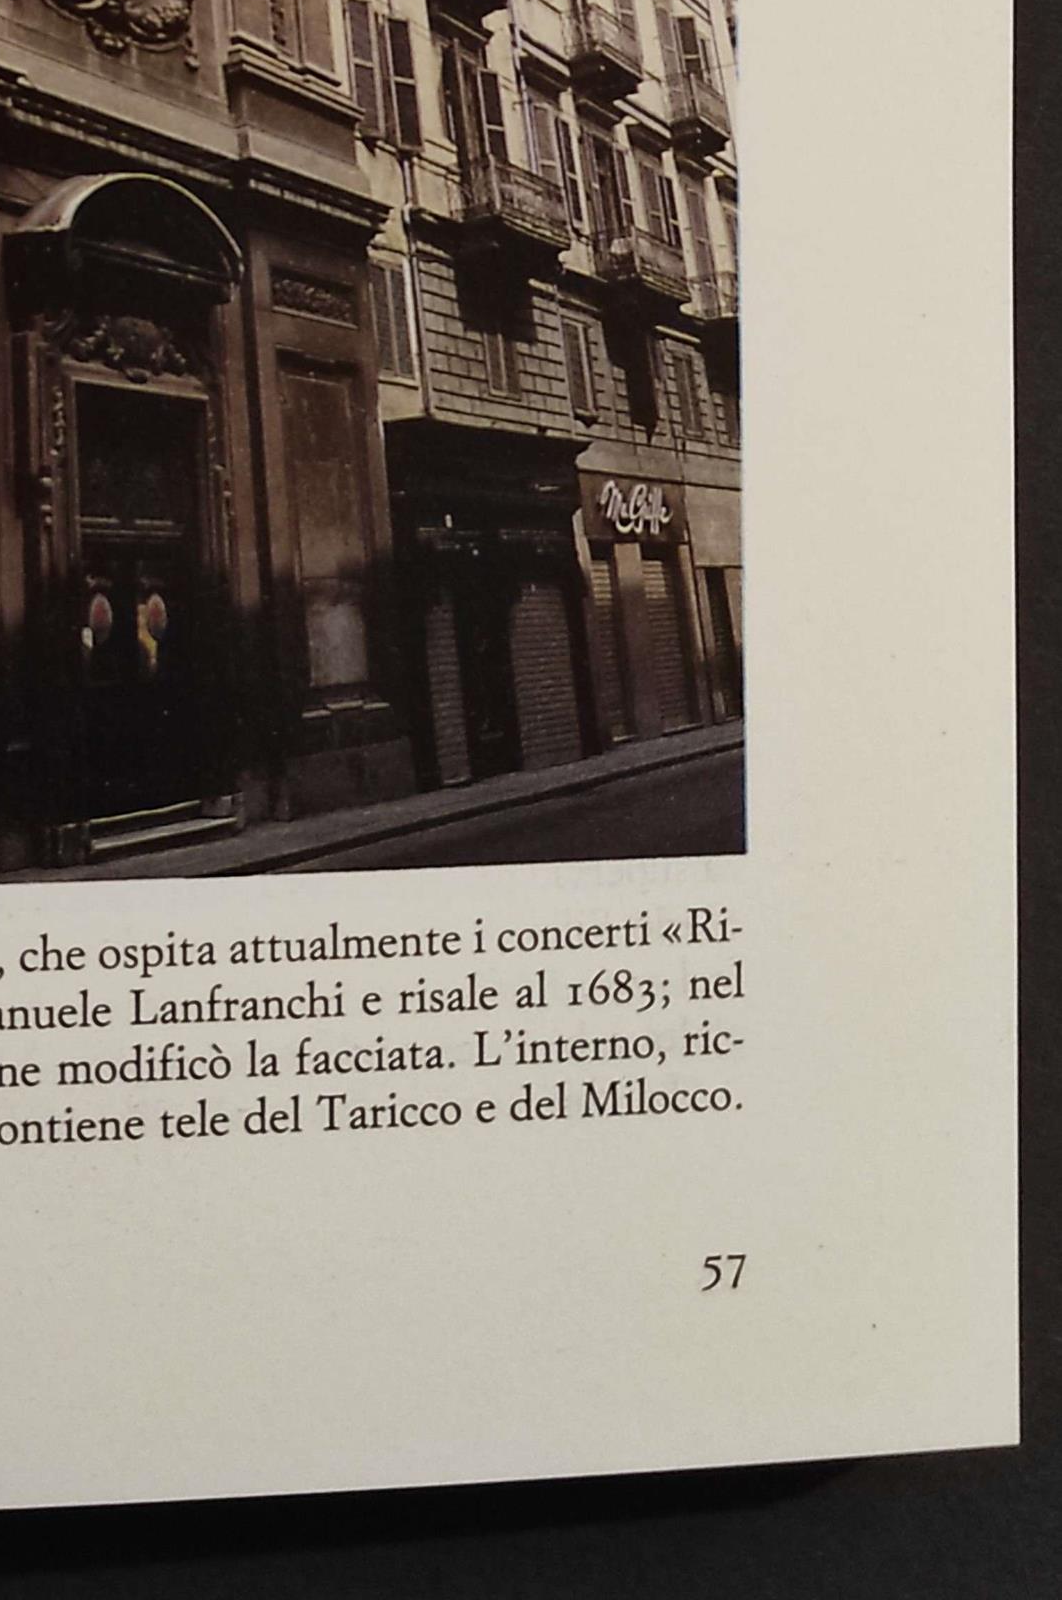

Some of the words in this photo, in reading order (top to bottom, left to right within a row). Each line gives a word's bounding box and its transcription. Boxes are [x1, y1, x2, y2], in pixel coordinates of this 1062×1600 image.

[18, 932, 87, 973] che
[98, 930, 218, 979] ospita
[229, 921, 462, 965] attualmente
[473, 917, 487, 955] i
[496, 910, 652, 954] concerti
[661, 906, 743, 945] «Ri-
[129, 979, 347, 1026] Lanfranchi
[361, 992, 383, 1017] e
[397, 972, 499, 1015] risale
[515, 969, 549, 1010] al
[567, 968, 671, 1014] 1683;
[688, 959, 746, 1001] nel
[56, 1041, 232, 1086] modificò
[246, 1038, 281, 1078] la
[295, 1035, 456, 1076] facciata.
[473, 1028, 667, 1068] L’interno,
[683, 1019, 745, 1057] ric-
[159, 1098, 231, 1140] tele
[243, 1094, 303, 1136] del
[315, 1091, 462, 1132] Taricco
[475, 1099, 497, 1124] e
[509, 1080, 568, 1123] del
[581, 1076, 743, 1119] Milocco.
[701, 1254, 746, 1291] 57
